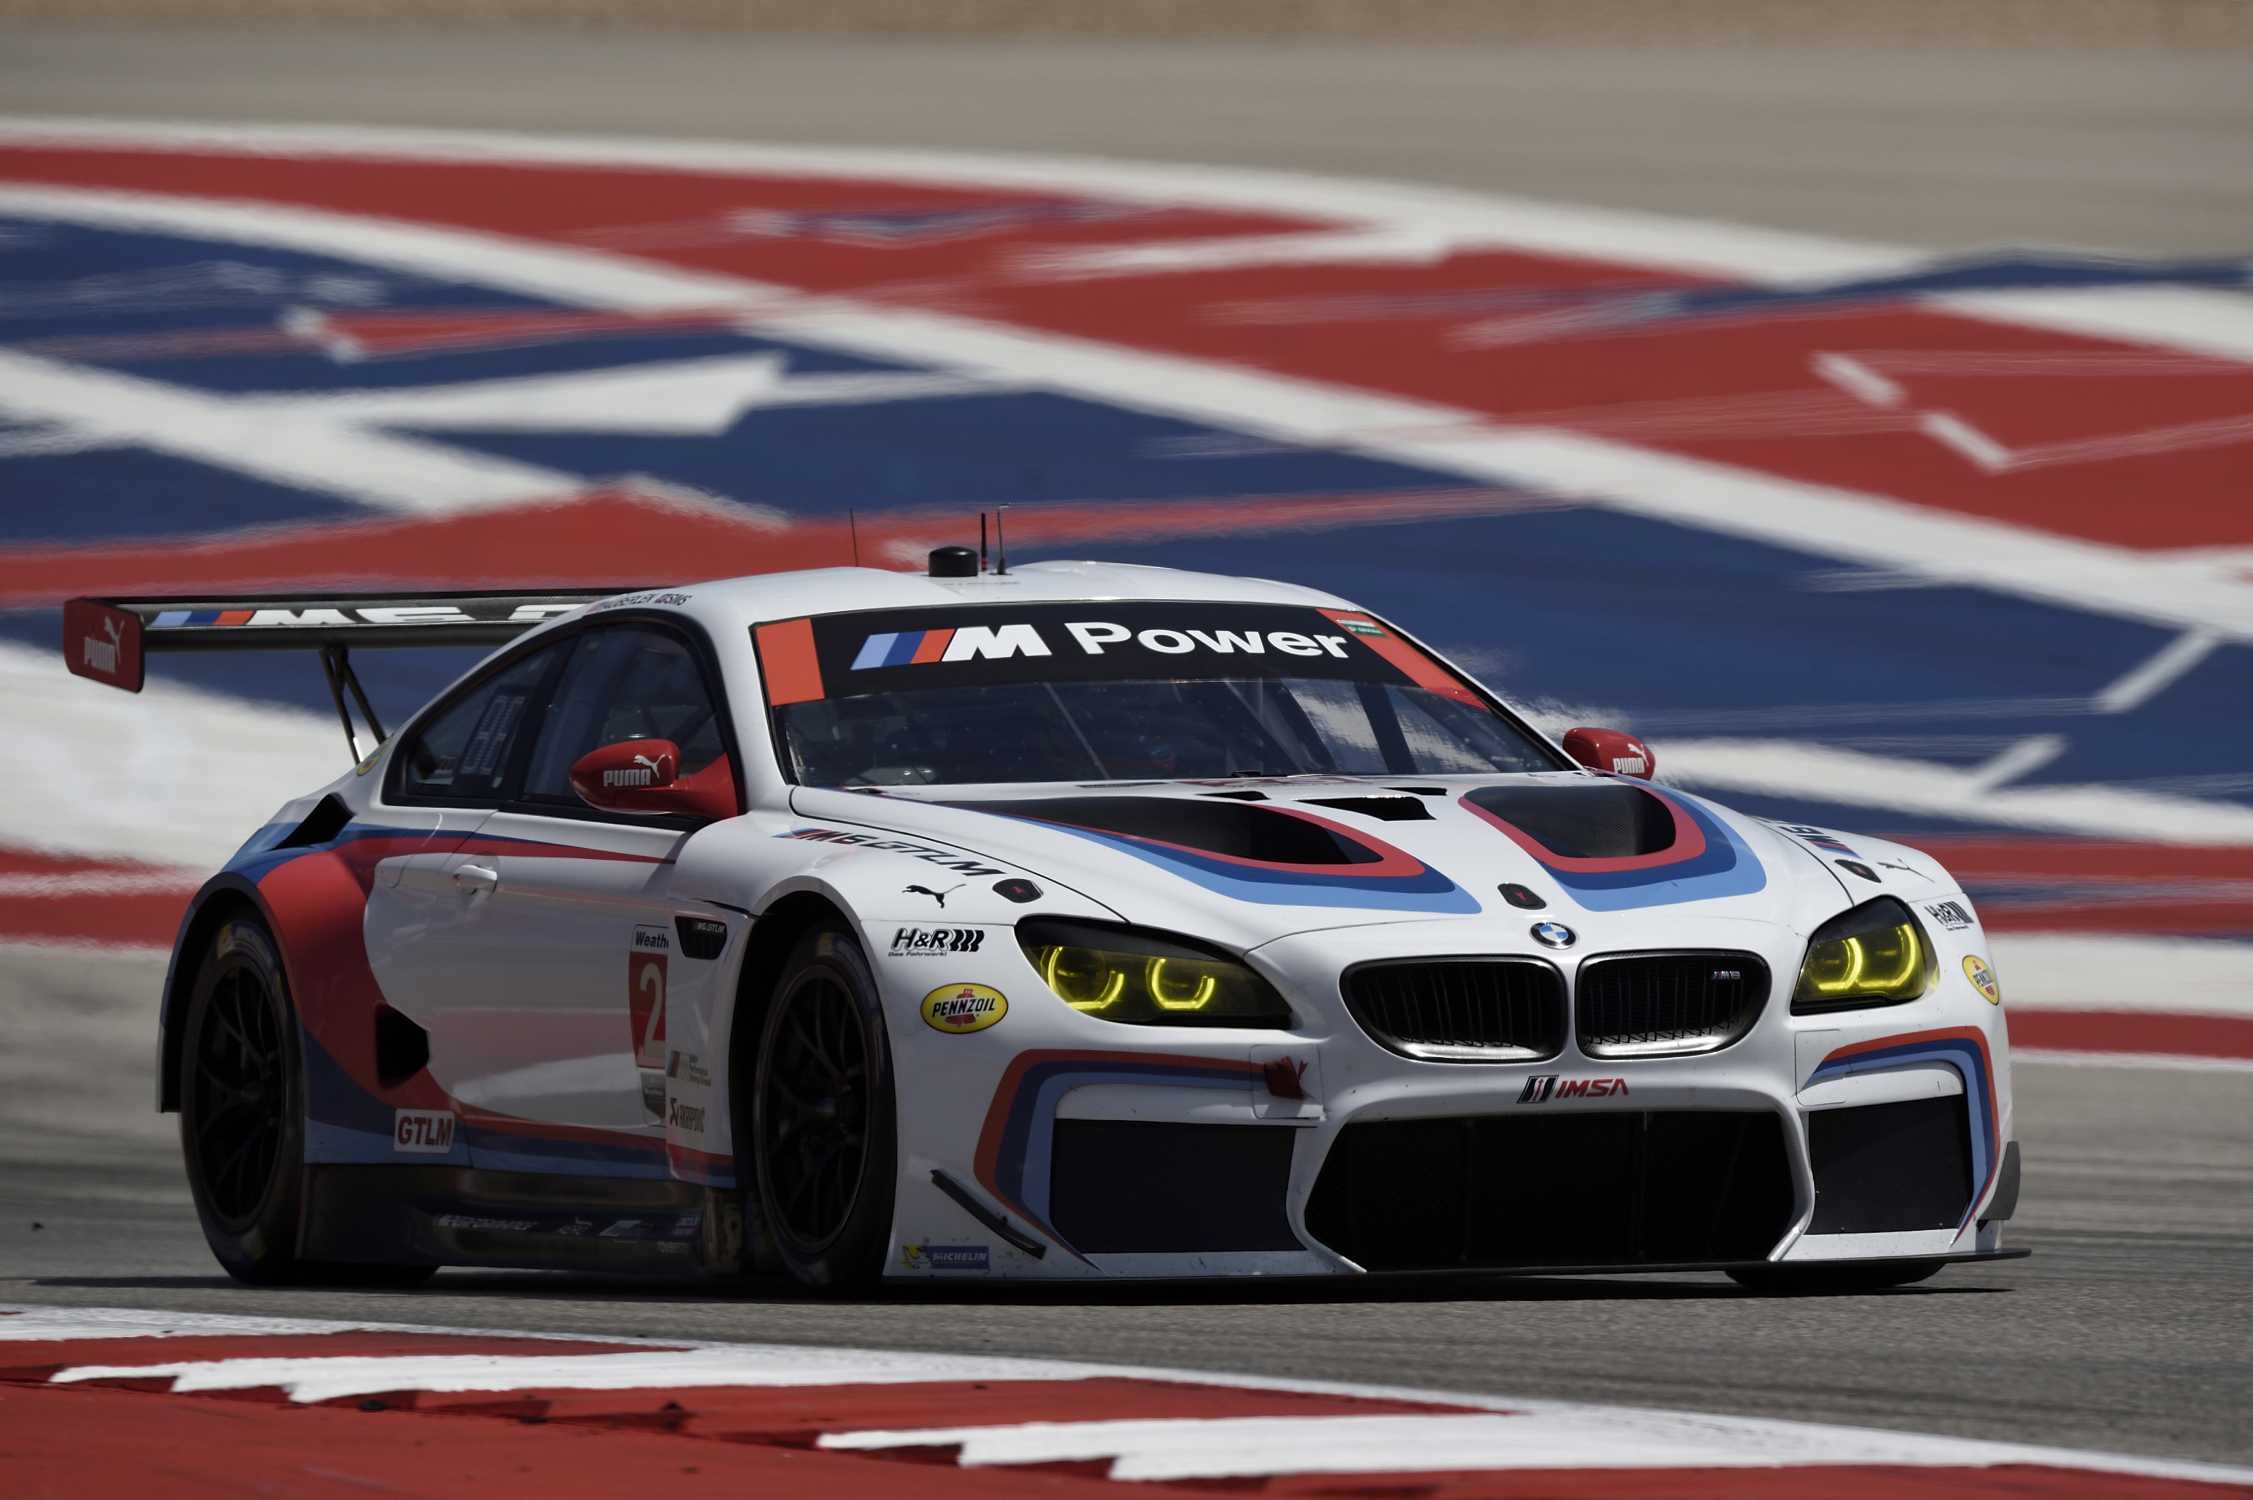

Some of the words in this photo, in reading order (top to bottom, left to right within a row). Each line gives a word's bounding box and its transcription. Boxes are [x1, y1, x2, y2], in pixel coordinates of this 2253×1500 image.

[940, 624, 1053, 662] M
[1064, 621, 1349, 659] Power
[84, 637, 115, 673] PUMA
[1613, 757, 1645, 774] PUMA
[603, 769, 651, 787] PUMA
[860, 841, 1006, 876] GTLM
[892, 928, 950, 951] H&R
[932, 998, 996, 1018] PENNZOIL
[1555, 1078, 1630, 1098] IMSA
[398, 1116, 453, 1147] GTLM
[931, 1252, 988, 1262] MICHELIN
